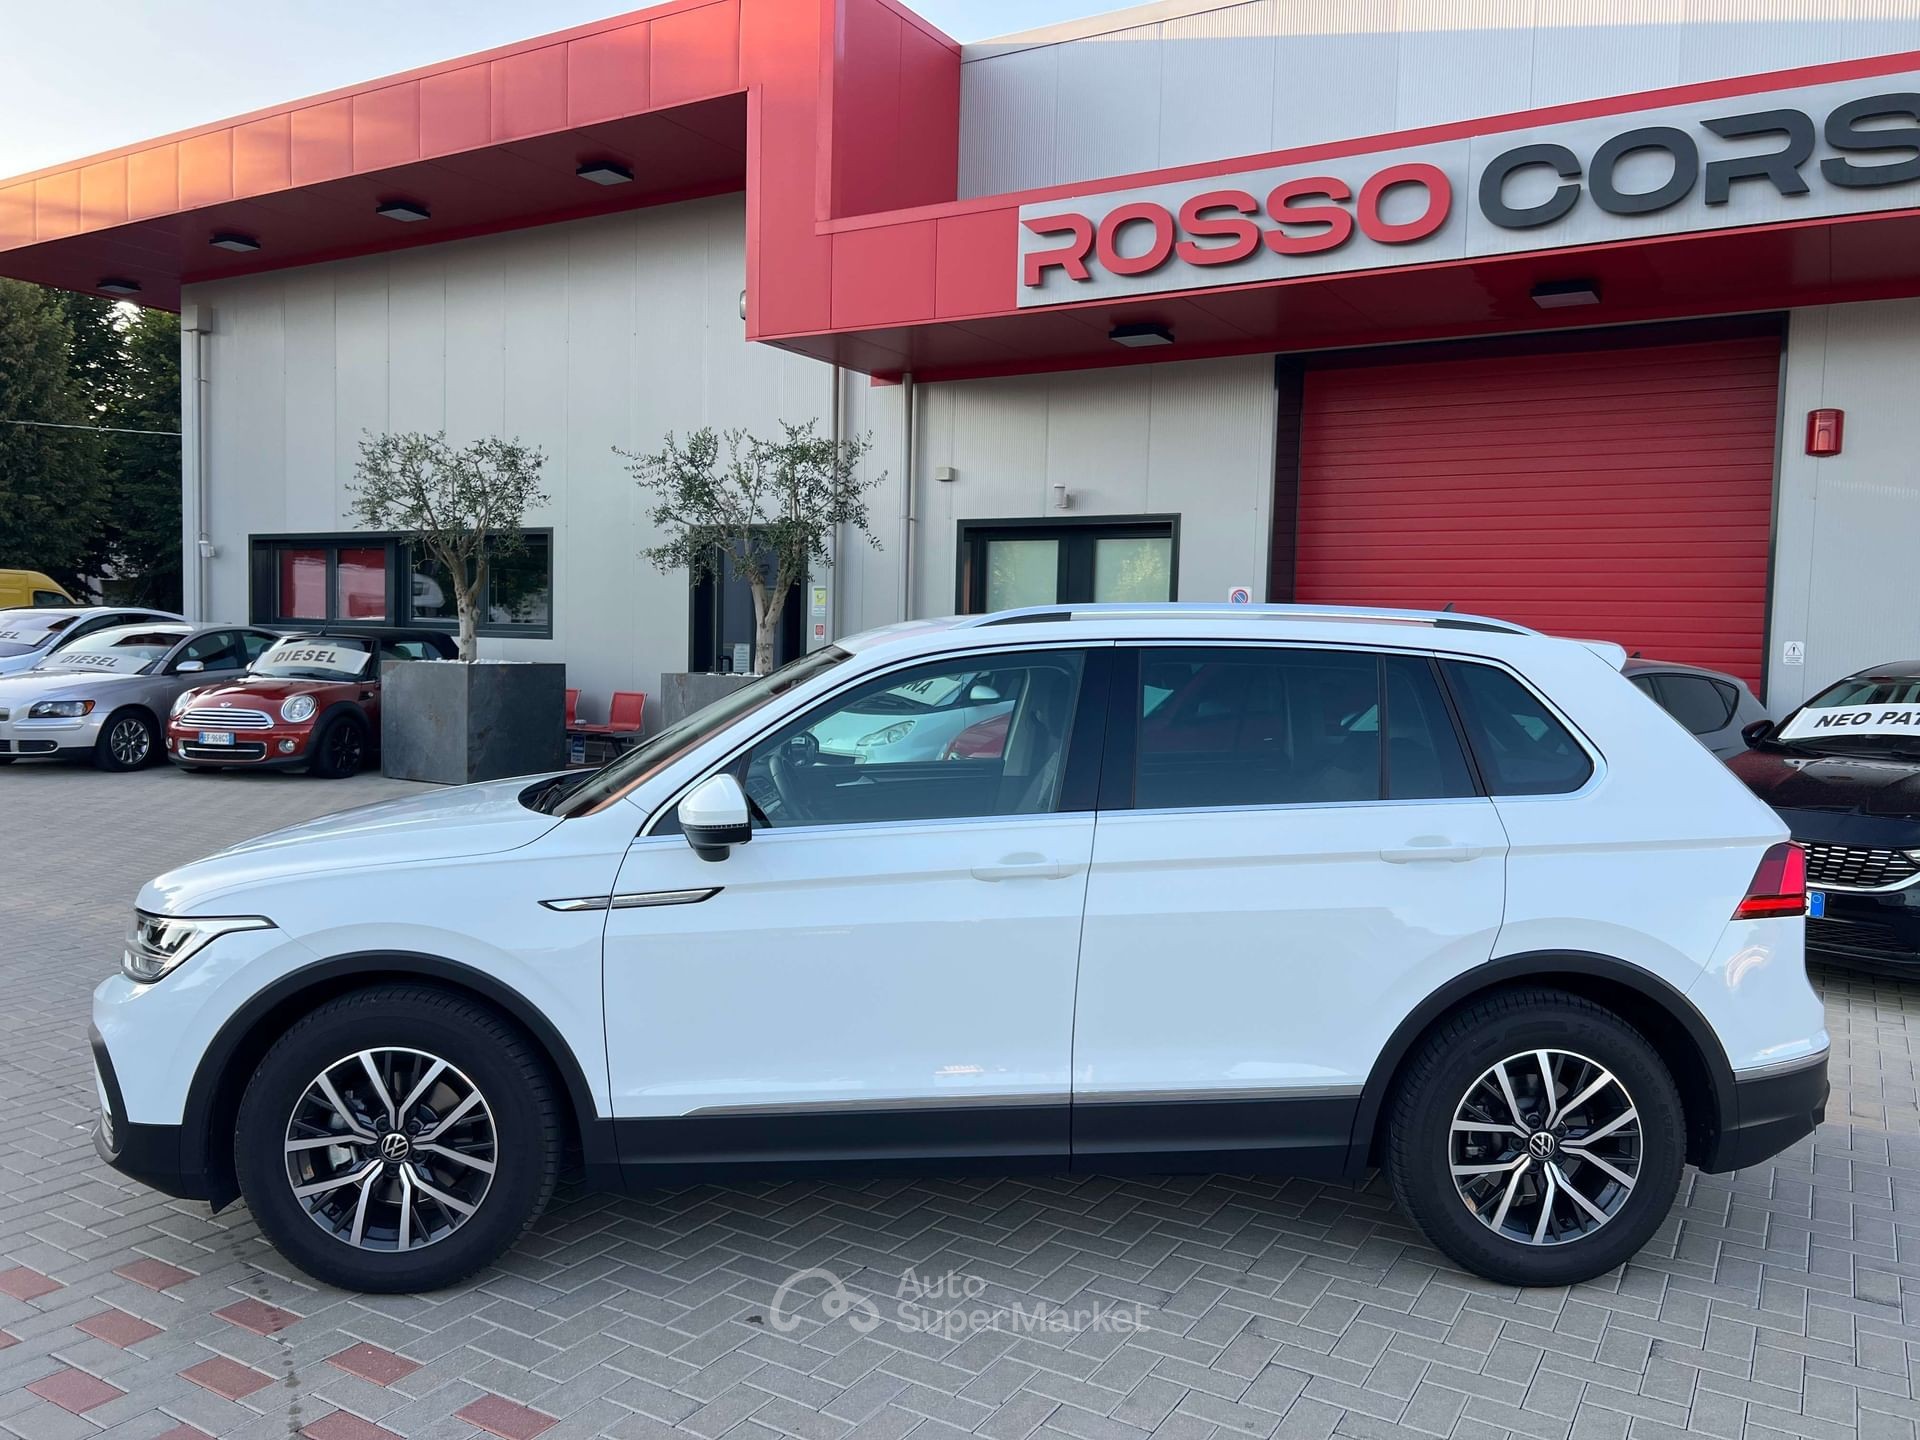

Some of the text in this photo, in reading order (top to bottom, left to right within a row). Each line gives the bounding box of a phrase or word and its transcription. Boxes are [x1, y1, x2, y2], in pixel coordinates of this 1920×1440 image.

[1020, 92, 1920, 288] ROSSO CORS
[0, 631, 20, 640] EL
[60, 655, 118, 668] DIESEL
[272, 649, 336, 664] DIESEL
[1813, 712, 1872, 729] NEO
